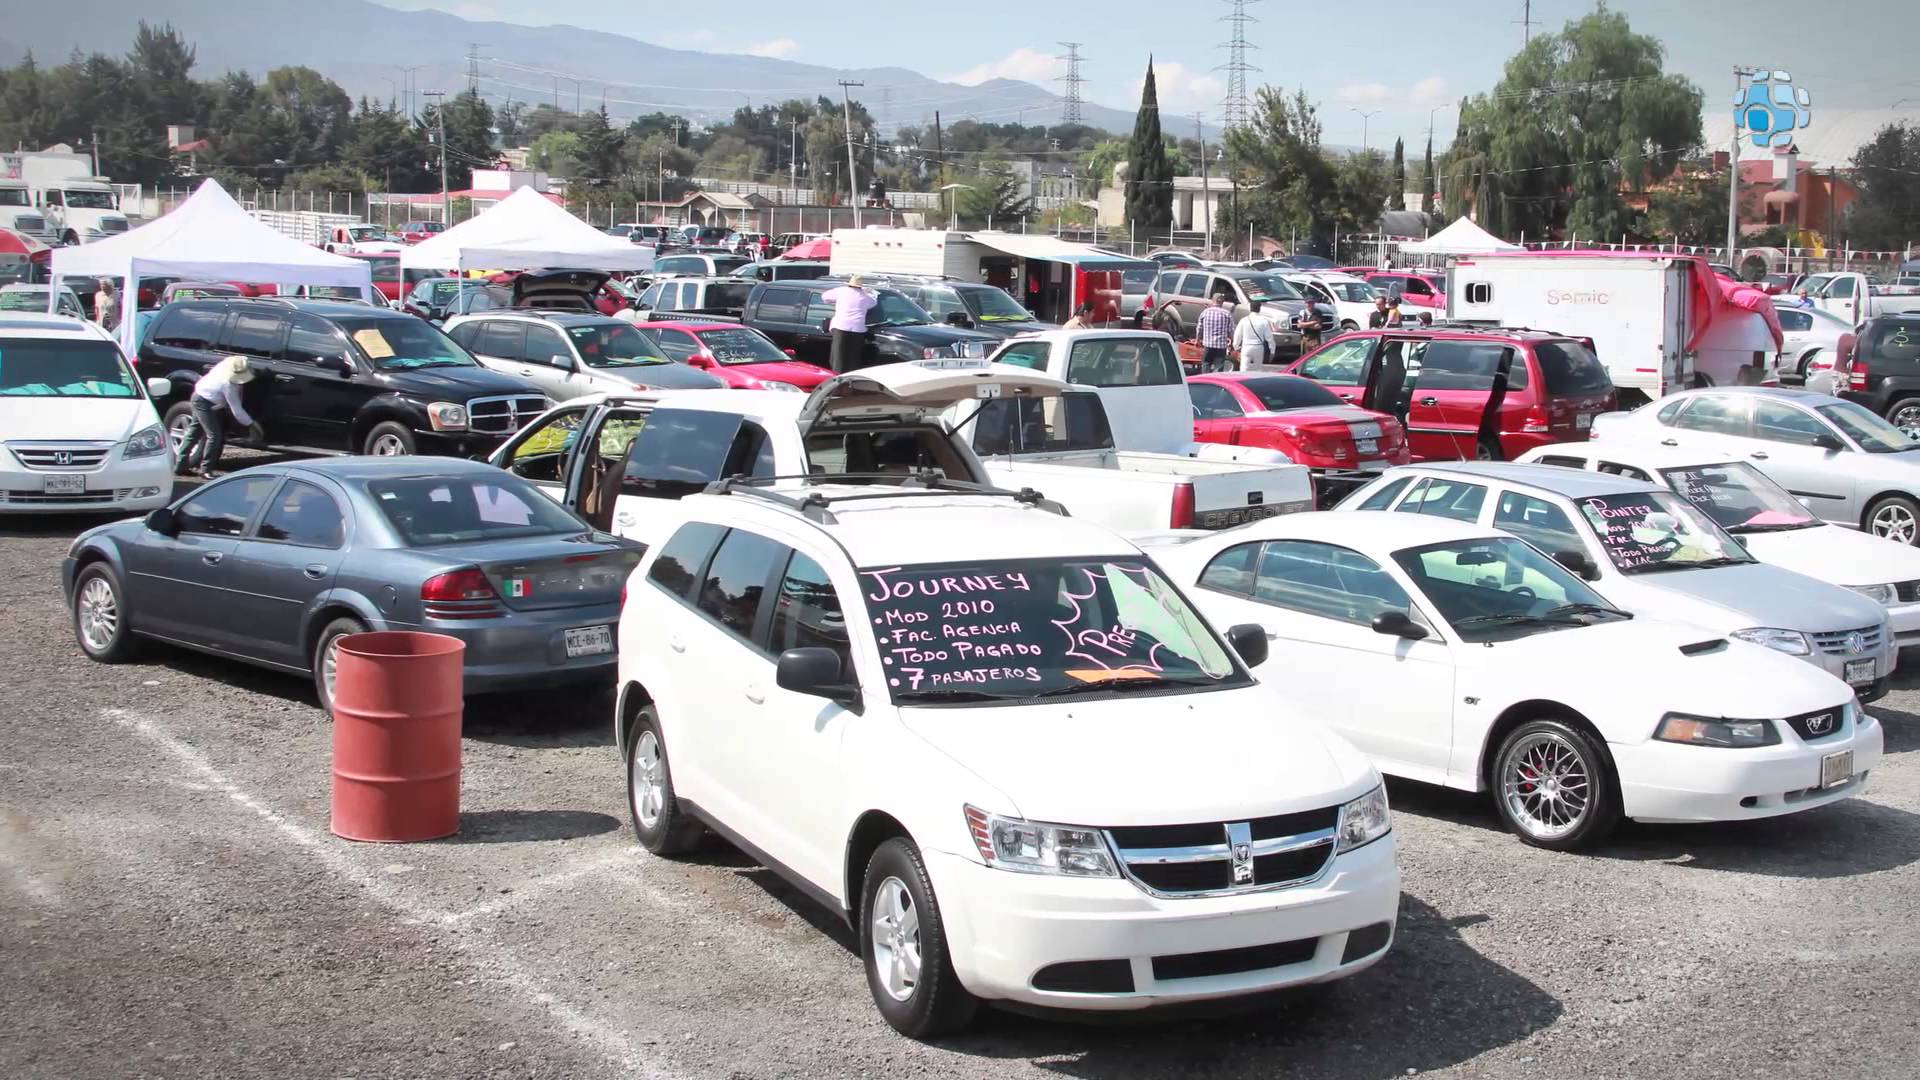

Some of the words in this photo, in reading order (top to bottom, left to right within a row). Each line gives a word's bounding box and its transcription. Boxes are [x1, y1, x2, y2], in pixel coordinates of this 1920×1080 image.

[1585, 498, 1652, 519] POINTER
[1612, 546, 1641, 558] TODO
[859, 566, 1031, 602] JOURNEY
[885, 608, 929, 625] MOD
[942, 600, 995, 618] 2010
[891, 629, 937, 644] FAC.
[942, 622, 1022, 638] AGENCIA
[891, 647, 948, 663] TODO
[951, 641, 1042, 660] PAGADO
[900, 667, 925, 690] 7
[931, 666, 1042, 686] PASAJEROS
